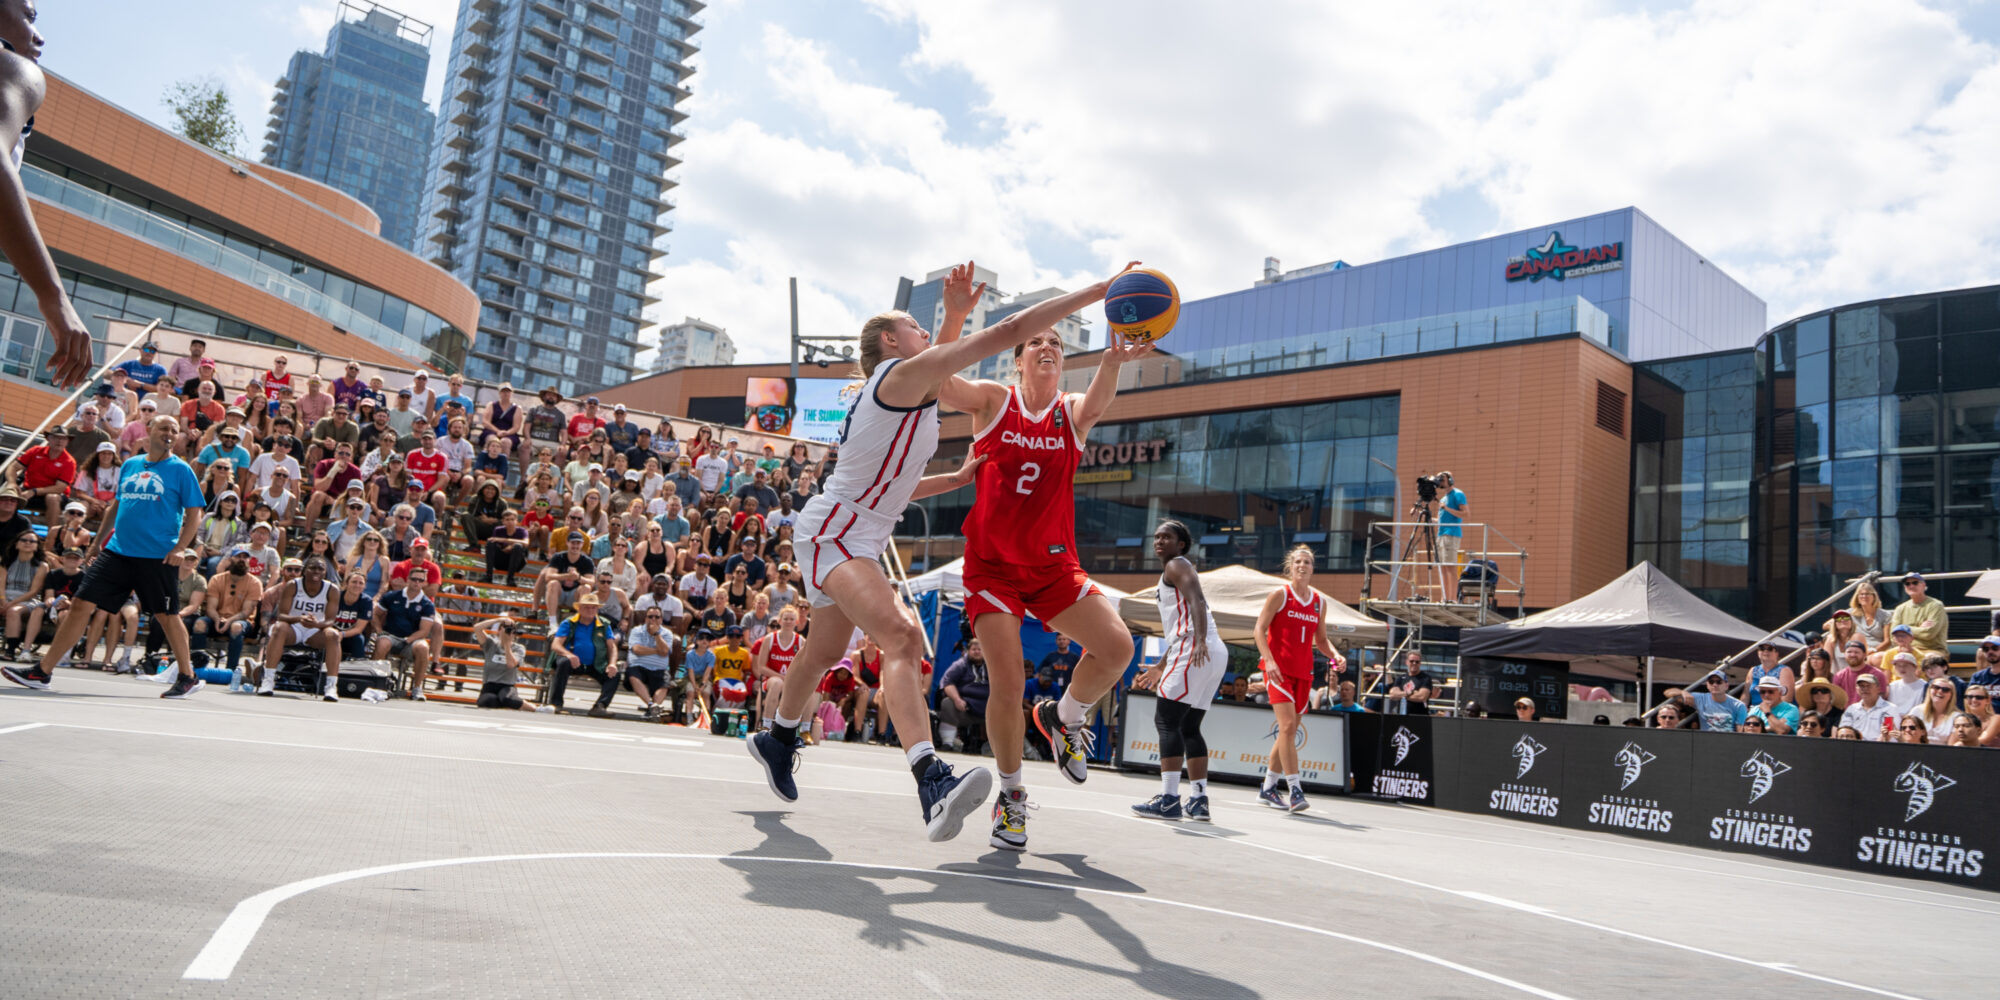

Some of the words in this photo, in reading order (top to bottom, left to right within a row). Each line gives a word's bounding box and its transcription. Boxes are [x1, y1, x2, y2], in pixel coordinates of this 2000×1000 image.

[1505, 244, 1618, 278] CANADIAN
[803, 409, 817, 421] THE
[1001, 430, 1065, 450] CANADA
[1080, 439, 1166, 467] NQUET
[1016, 462, 1041, 495] 2
[294, 601, 325, 613] USA
[1287, 610, 1319, 624] CANADA
[1301, 626, 1306, 644] 1
[771, 653, 796, 663] CANAD
[1473, 677, 1489, 690] 12
[1540, 684, 1556, 696] 15
[1240, 753, 1337, 773] BASBALL
[1372, 775, 1429, 800] STINGERS
[1502, 783, 1548, 795] EDMONTON
[1489, 789, 1560, 817] STINGERS
[1602, 794, 1659, 808] EDMONTON
[1588, 802, 1673, 833] STINGERS
[1726, 808, 1795, 825] EDMONTON
[1709, 816, 1813, 852] STINGERS
[1878, 826, 1961, 845] EDMONTON
[1857, 836, 1985, 878] STINGERS
